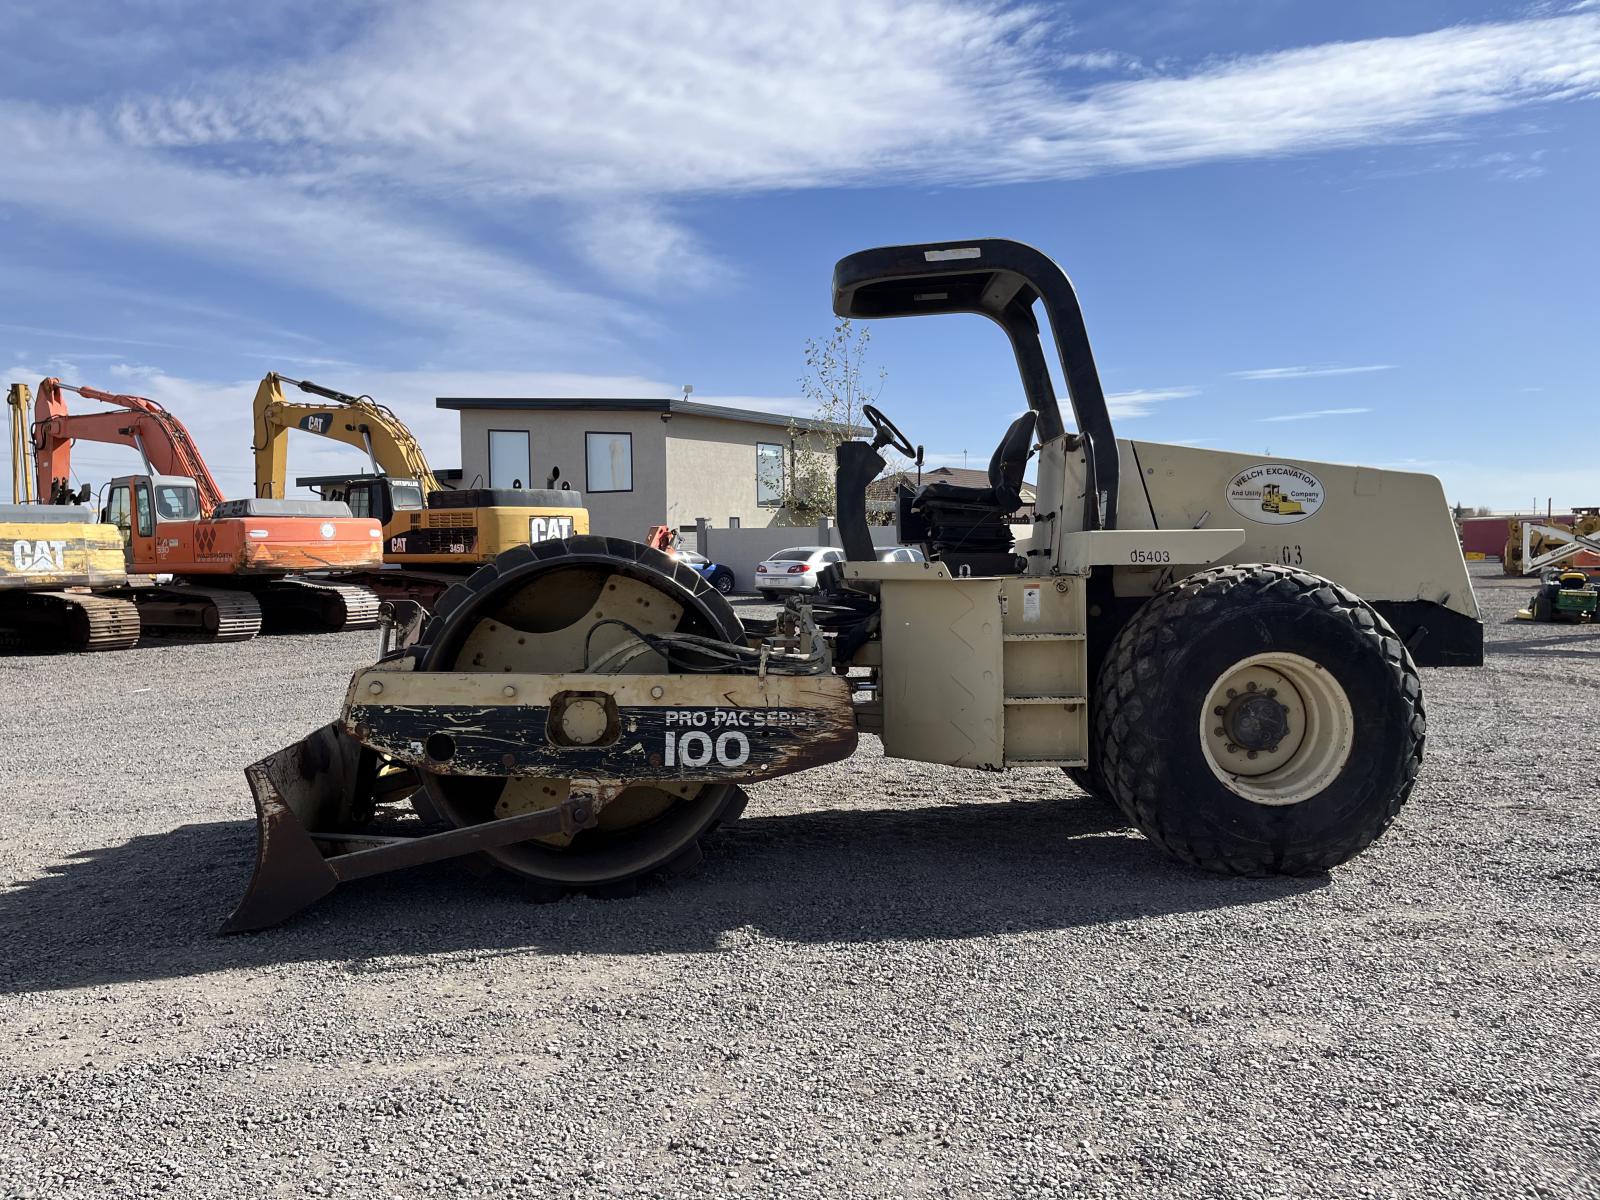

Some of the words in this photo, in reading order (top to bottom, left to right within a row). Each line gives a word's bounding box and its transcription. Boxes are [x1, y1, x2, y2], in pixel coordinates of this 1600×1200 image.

[308, 415, 323, 432] CAT
[1234, 468, 1264, 488] WELCH
[1266, 467, 1317, 488] EXCAVATION
[1244, 489, 1262, 498] Utility
[1291, 490, 1319, 498] Company
[531, 517, 571, 544] CAT
[391, 537, 407, 553] CAT
[449, 543, 465, 553] 345D
[13, 540, 67, 572] CAT
[1130, 550, 1170, 563] 05403
[664, 730, 751, 768] 100
